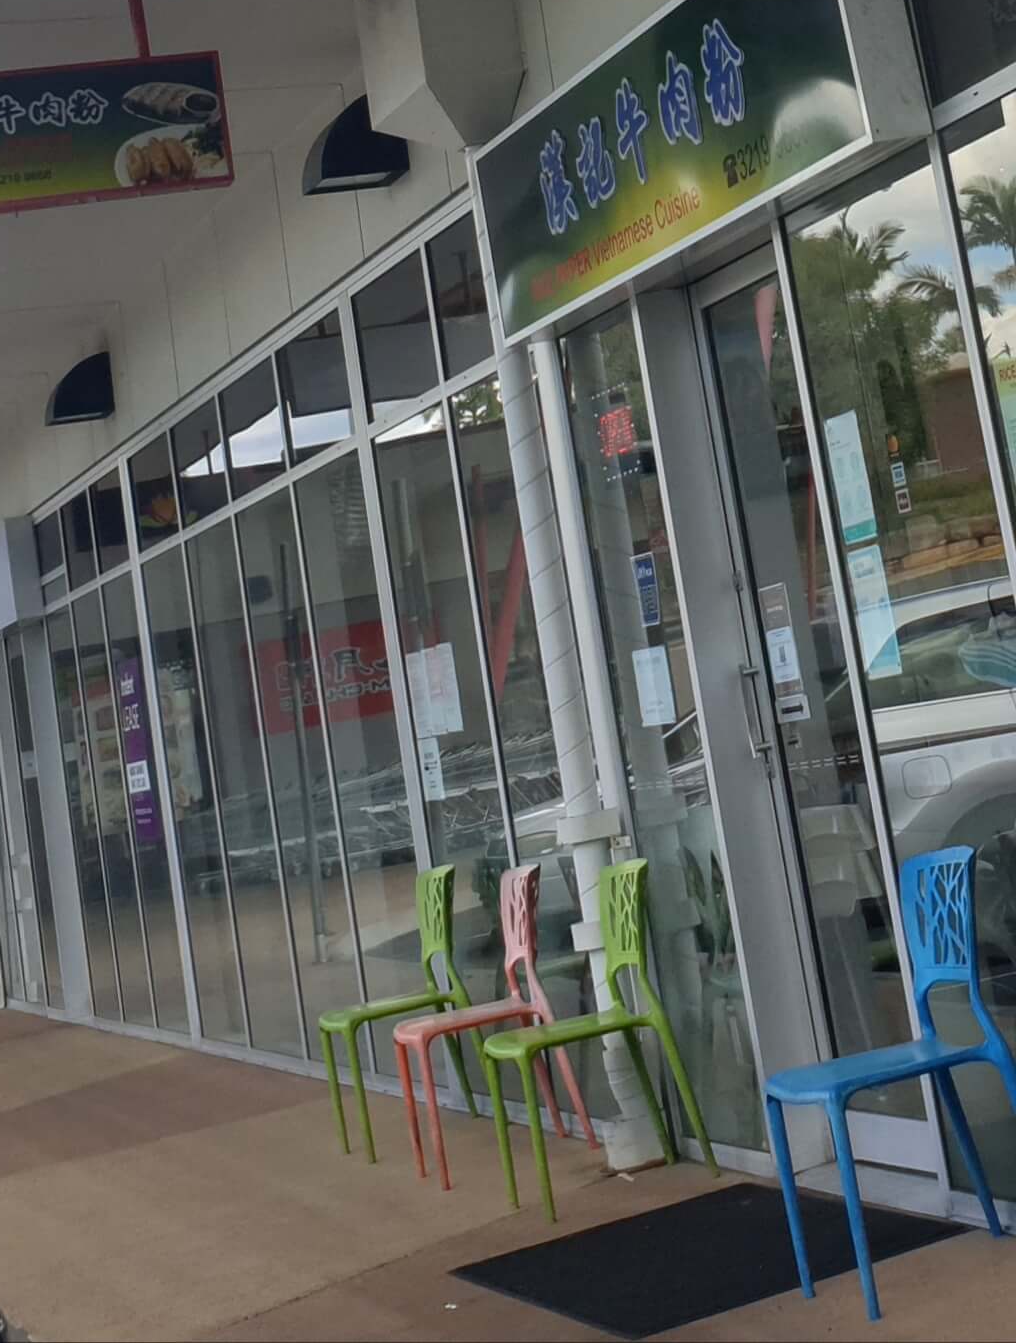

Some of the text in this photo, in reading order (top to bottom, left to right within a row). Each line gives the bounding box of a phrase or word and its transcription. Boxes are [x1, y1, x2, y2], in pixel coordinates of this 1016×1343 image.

[737, 135, 771, 180] 3219
[593, 213, 653, 267] Vietnamese
[654, 185, 701, 230] Cuisine
